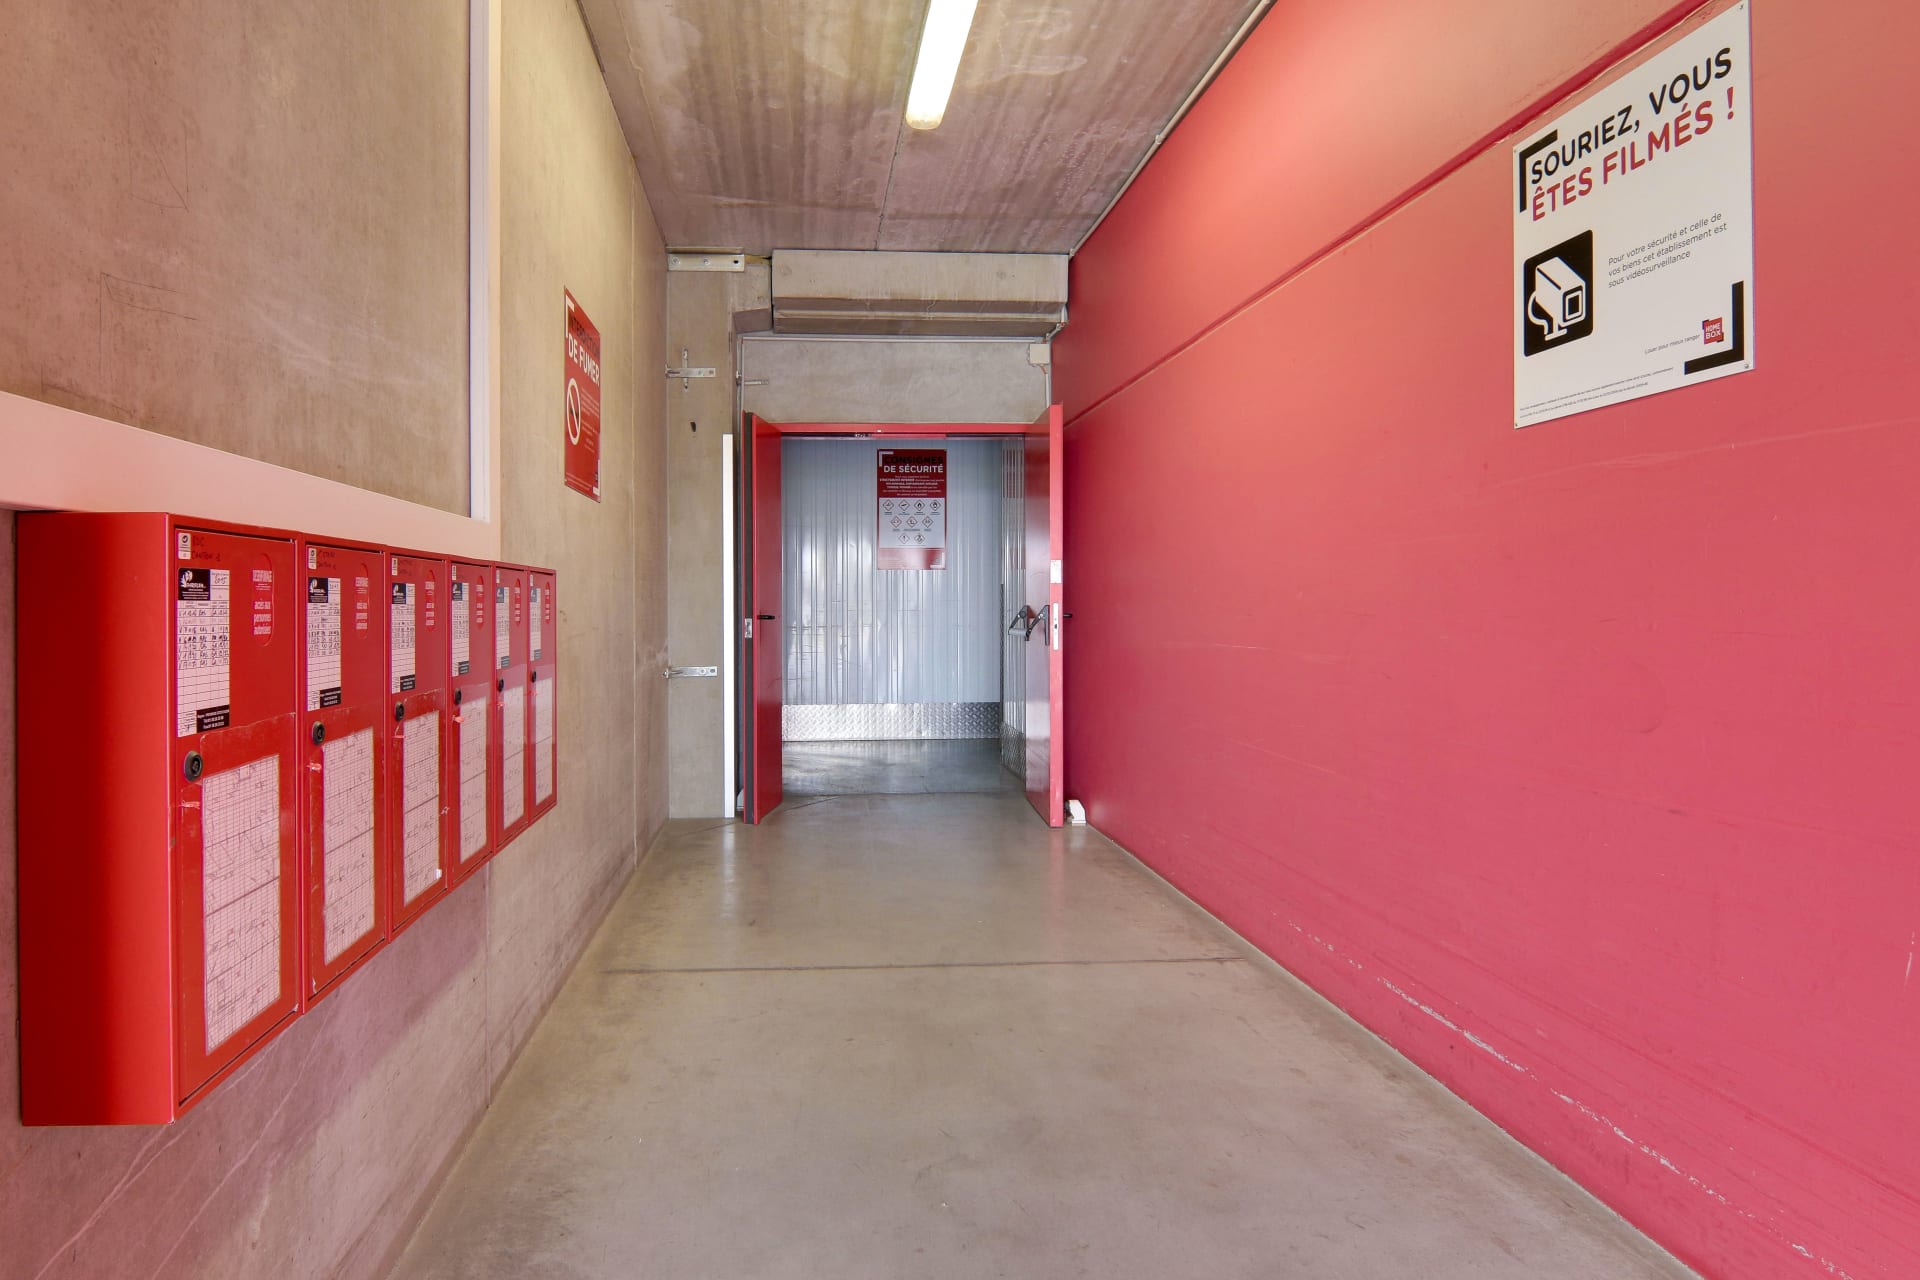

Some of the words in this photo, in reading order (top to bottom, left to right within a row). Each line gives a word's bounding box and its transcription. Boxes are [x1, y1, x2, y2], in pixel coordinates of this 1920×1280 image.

[1531, 104, 1640, 184] SOURIEZ,
[1649, 47, 1732, 115] VOUS
[1533, 167, 1593, 221] ÊTES
[1603, 100, 1713, 185] FILMÉS
[1608, 266, 1621, 277] vos
[1622, 258, 1641, 271] biens
[1643, 252, 1655, 263] cet
[1656, 229, 1712, 258] établissement
[1713, 223, 1727, 234] est
[1626, 245, 1646, 258] votre
[1647, 230, 1677, 250] sécurité
[1679, 227, 1687, 236] et
[1689, 218, 1709, 232] celle
[1710, 212, 1722, 223] de
[1608, 277, 1624, 288] sous
[1626, 250, 1690, 281] vidéosurveillance
[1705, 323, 1721, 333] HOME
[1705, 330, 1721, 339] BOX
[568, 333, 578, 364] DE
[579, 346, 600, 387] FUMER
[883, 465, 896, 473] DE
[898, 463, 944, 473] SÉCURITÉ
